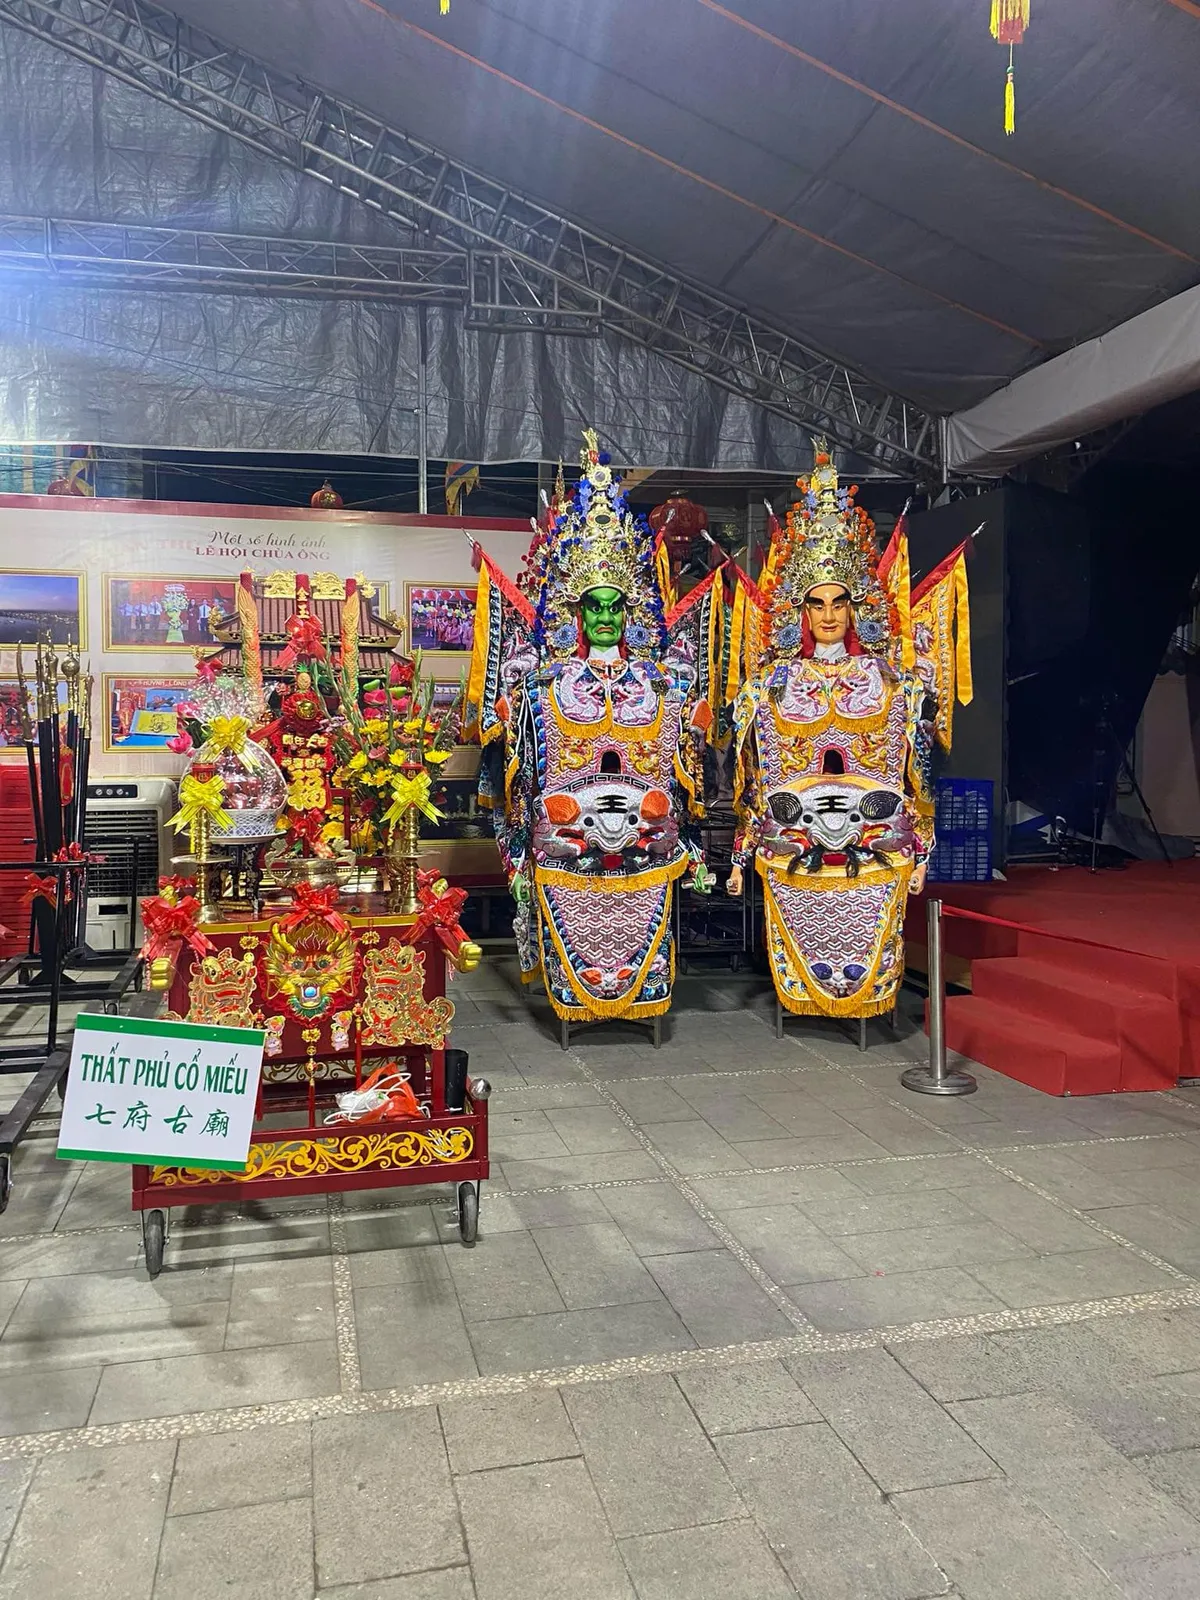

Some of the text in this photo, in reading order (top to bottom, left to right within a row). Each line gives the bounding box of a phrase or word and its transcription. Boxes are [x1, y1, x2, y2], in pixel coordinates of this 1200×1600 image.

[208, 530, 242, 545] Một
[247, 534, 264, 545] số
[266, 532, 296, 547] hình
[301, 535, 326, 548] ảnh
[217, 547, 247, 559] HỘI
[251, 547, 297, 559] CHÙA
[297, 548, 330, 560] ÔNG
[80, 1042, 248, 1095] THẤT PHỦ CỔ MIẾU
[85, 1100, 230, 1138] 七府古廟
